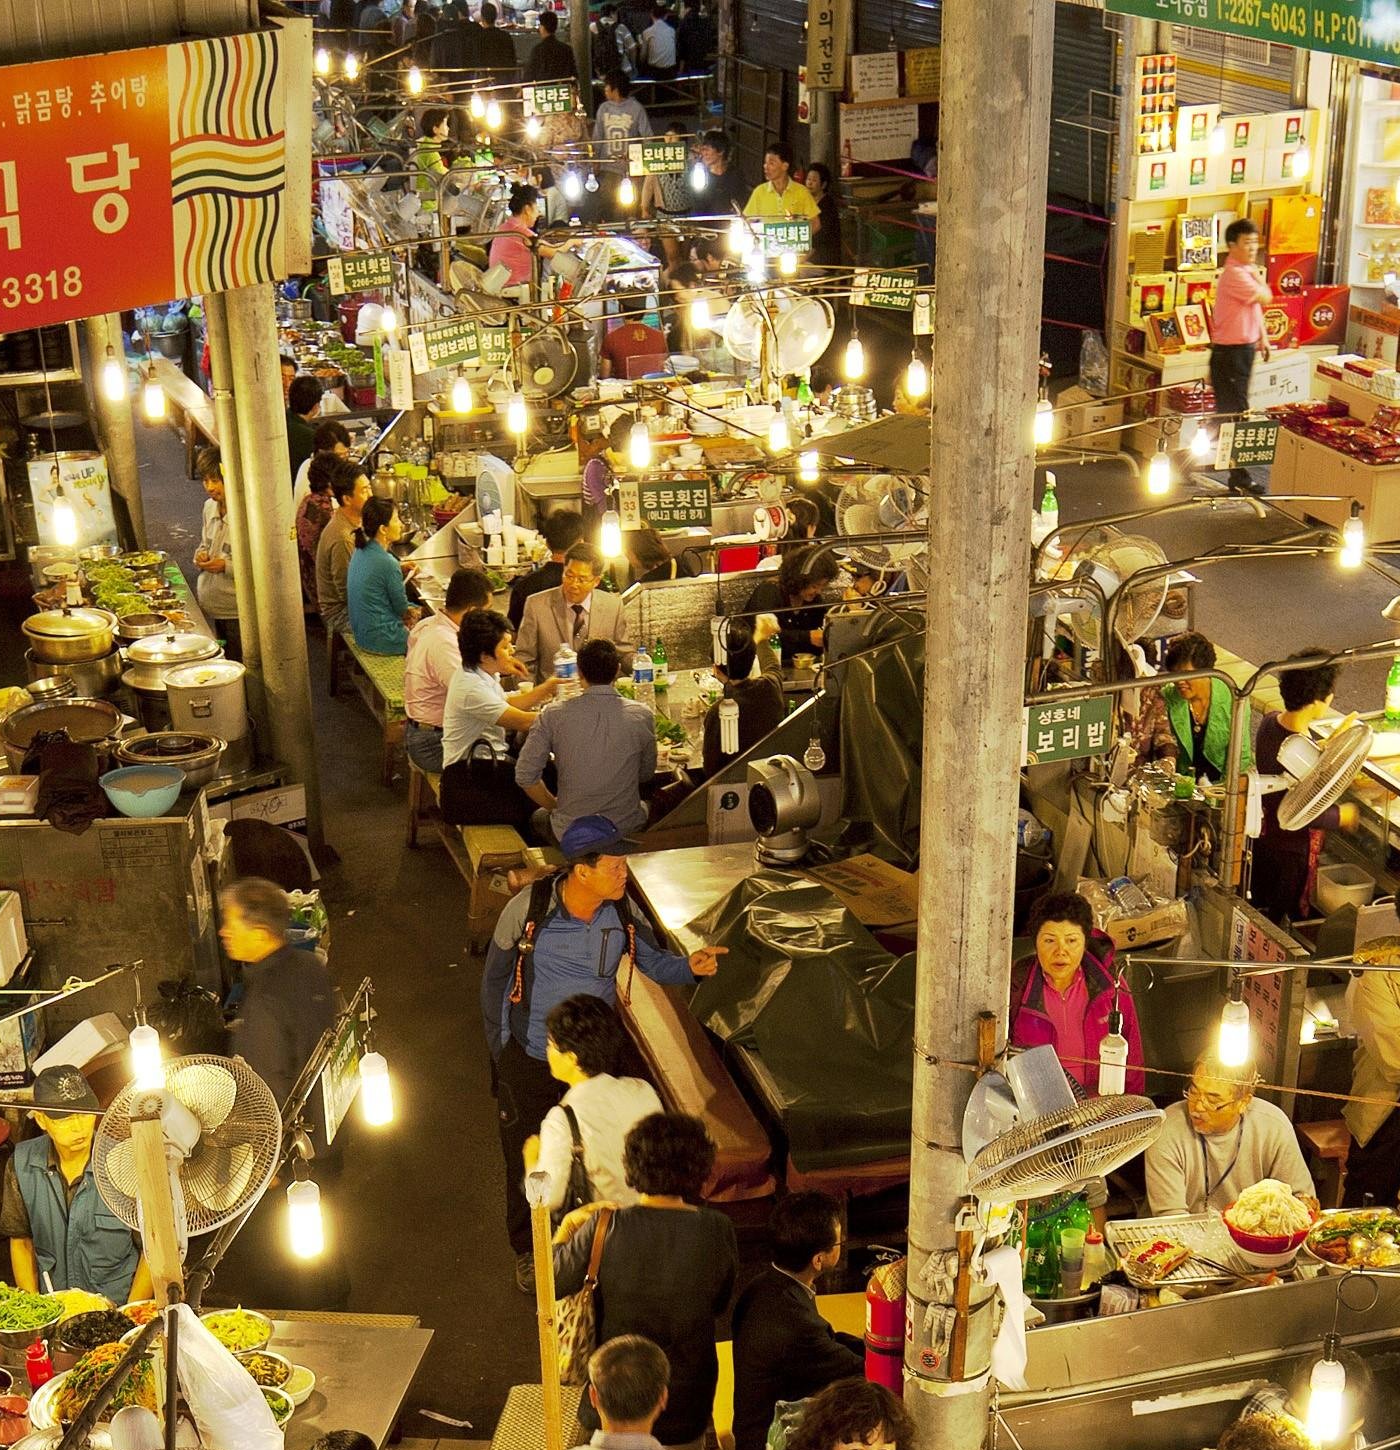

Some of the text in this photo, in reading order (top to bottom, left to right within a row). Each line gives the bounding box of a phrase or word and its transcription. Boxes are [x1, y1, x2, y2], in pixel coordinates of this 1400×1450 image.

[90, 75, 149, 108] 추어탕
[344, 256, 391, 276] 모녀횟집
[1038, 705, 1081, 725] 성호네
[1035, 721, 1106, 754] 보리밥
